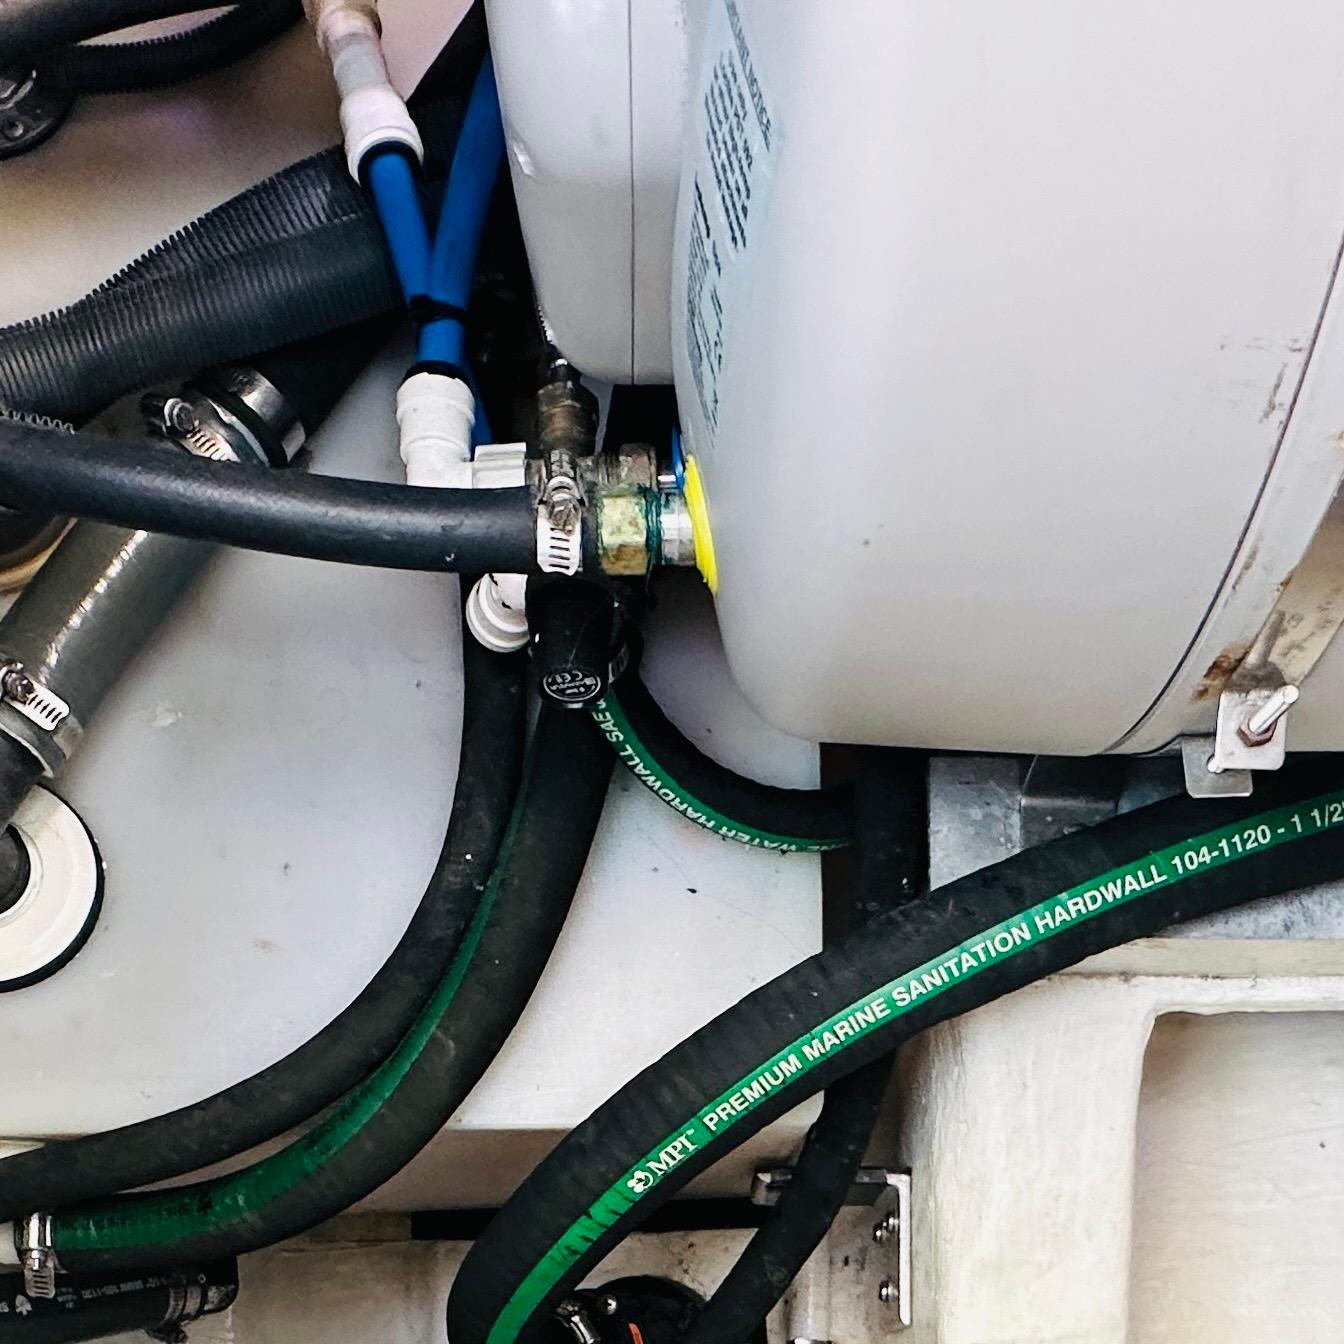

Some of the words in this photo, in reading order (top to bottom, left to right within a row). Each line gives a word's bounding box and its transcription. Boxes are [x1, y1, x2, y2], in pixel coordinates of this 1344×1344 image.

[591, 711, 623, 742] SAE
[618, 743, 715, 828] HARDWALL
[718, 825, 796, 850] WATER
[702, 1052, 802, 1131] PREMIUM
[802, 996, 892, 1062] MARINE
[889, 920, 1032, 1009] SANITATION
[1034, 863, 1168, 934] HARDWALL
[1170, 823, 1272, 875] 104-1120
